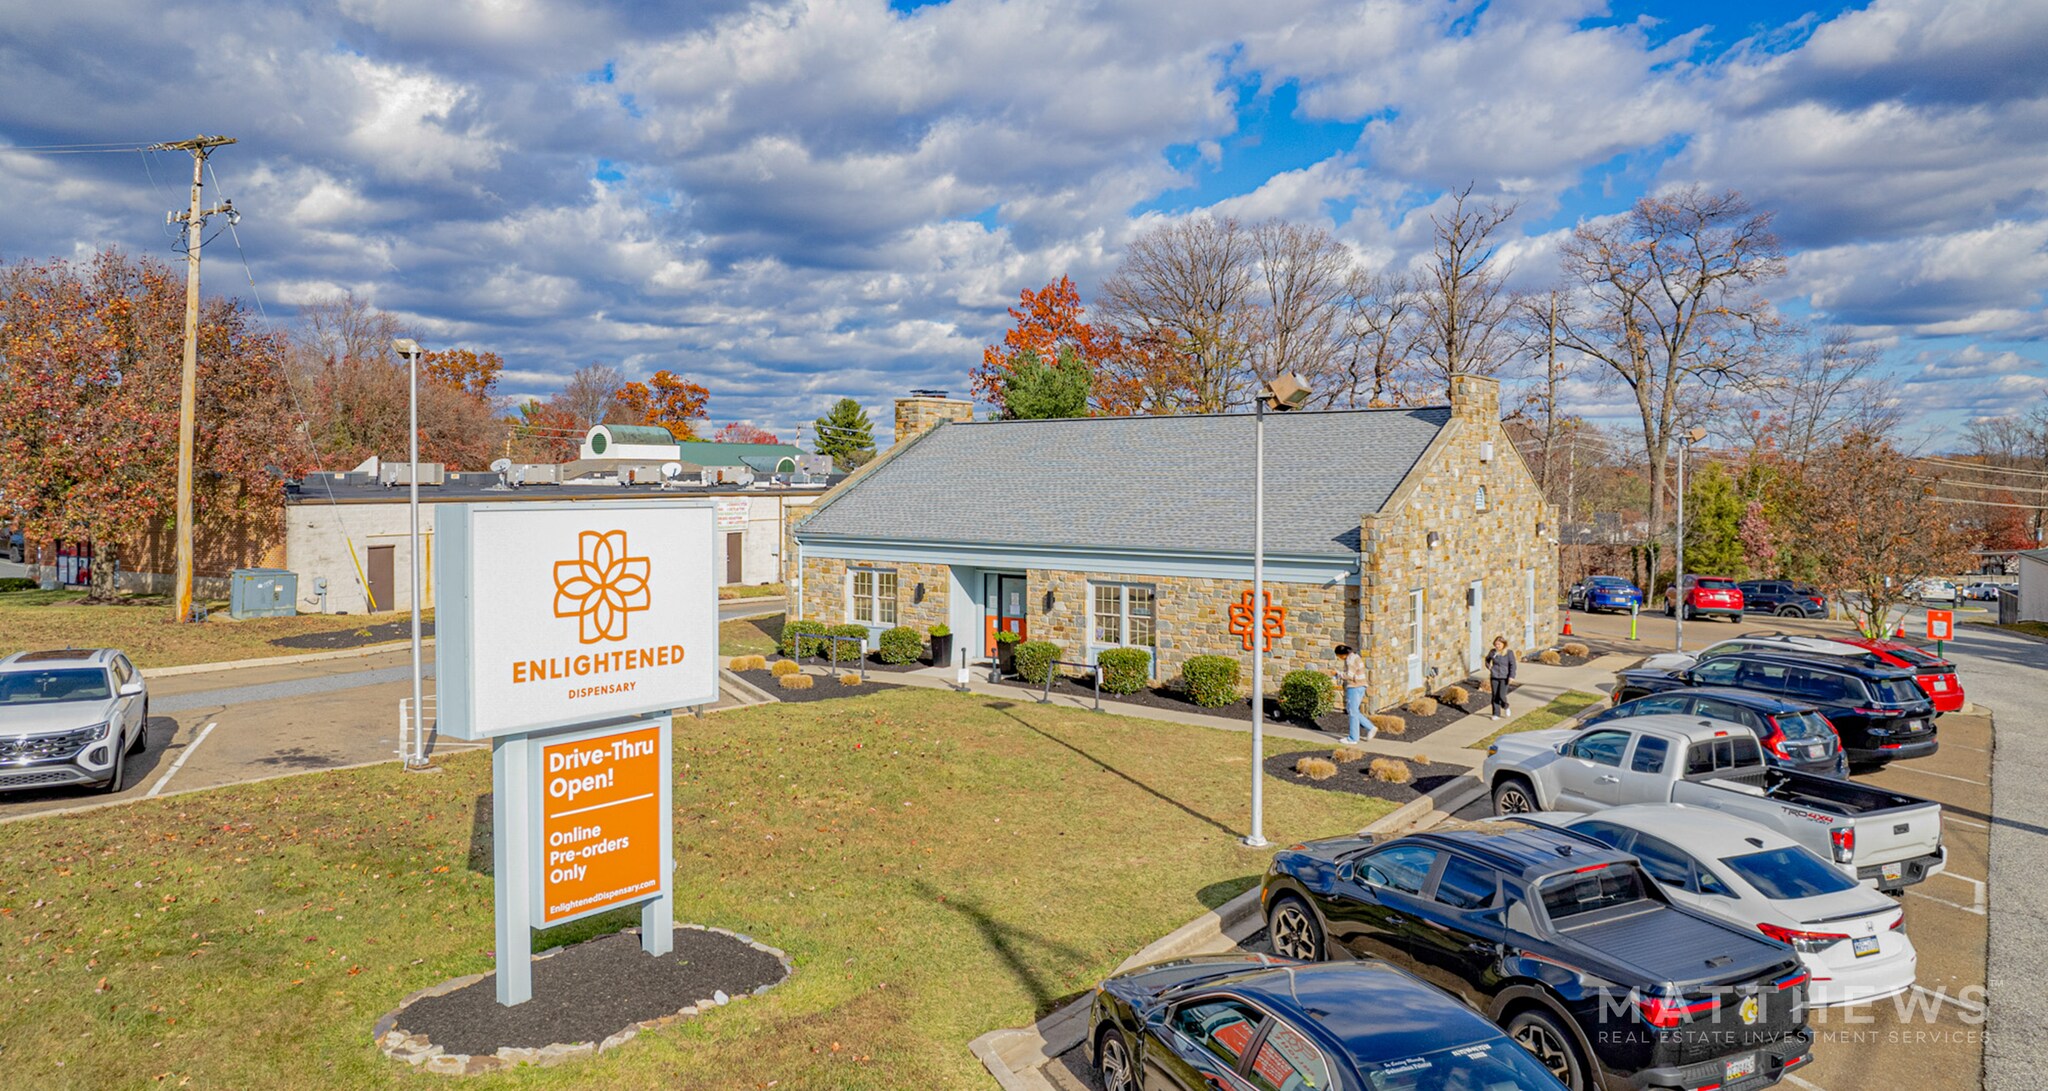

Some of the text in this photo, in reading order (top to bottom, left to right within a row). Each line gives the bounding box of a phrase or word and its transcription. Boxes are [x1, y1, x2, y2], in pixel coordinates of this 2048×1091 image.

[512, 644, 685, 684] ENLIGHTENED
[568, 681, 636, 699] DISPENSARY
[549, 739, 654, 773] Drive-Thru
[549, 768, 614, 801] Open!
[549, 825, 602, 847] Online
[549, 836, 630, 866] Pre-orders
[549, 864, 587, 884] Only
[549, 879, 656, 915] EnlightenedDispensary.com
